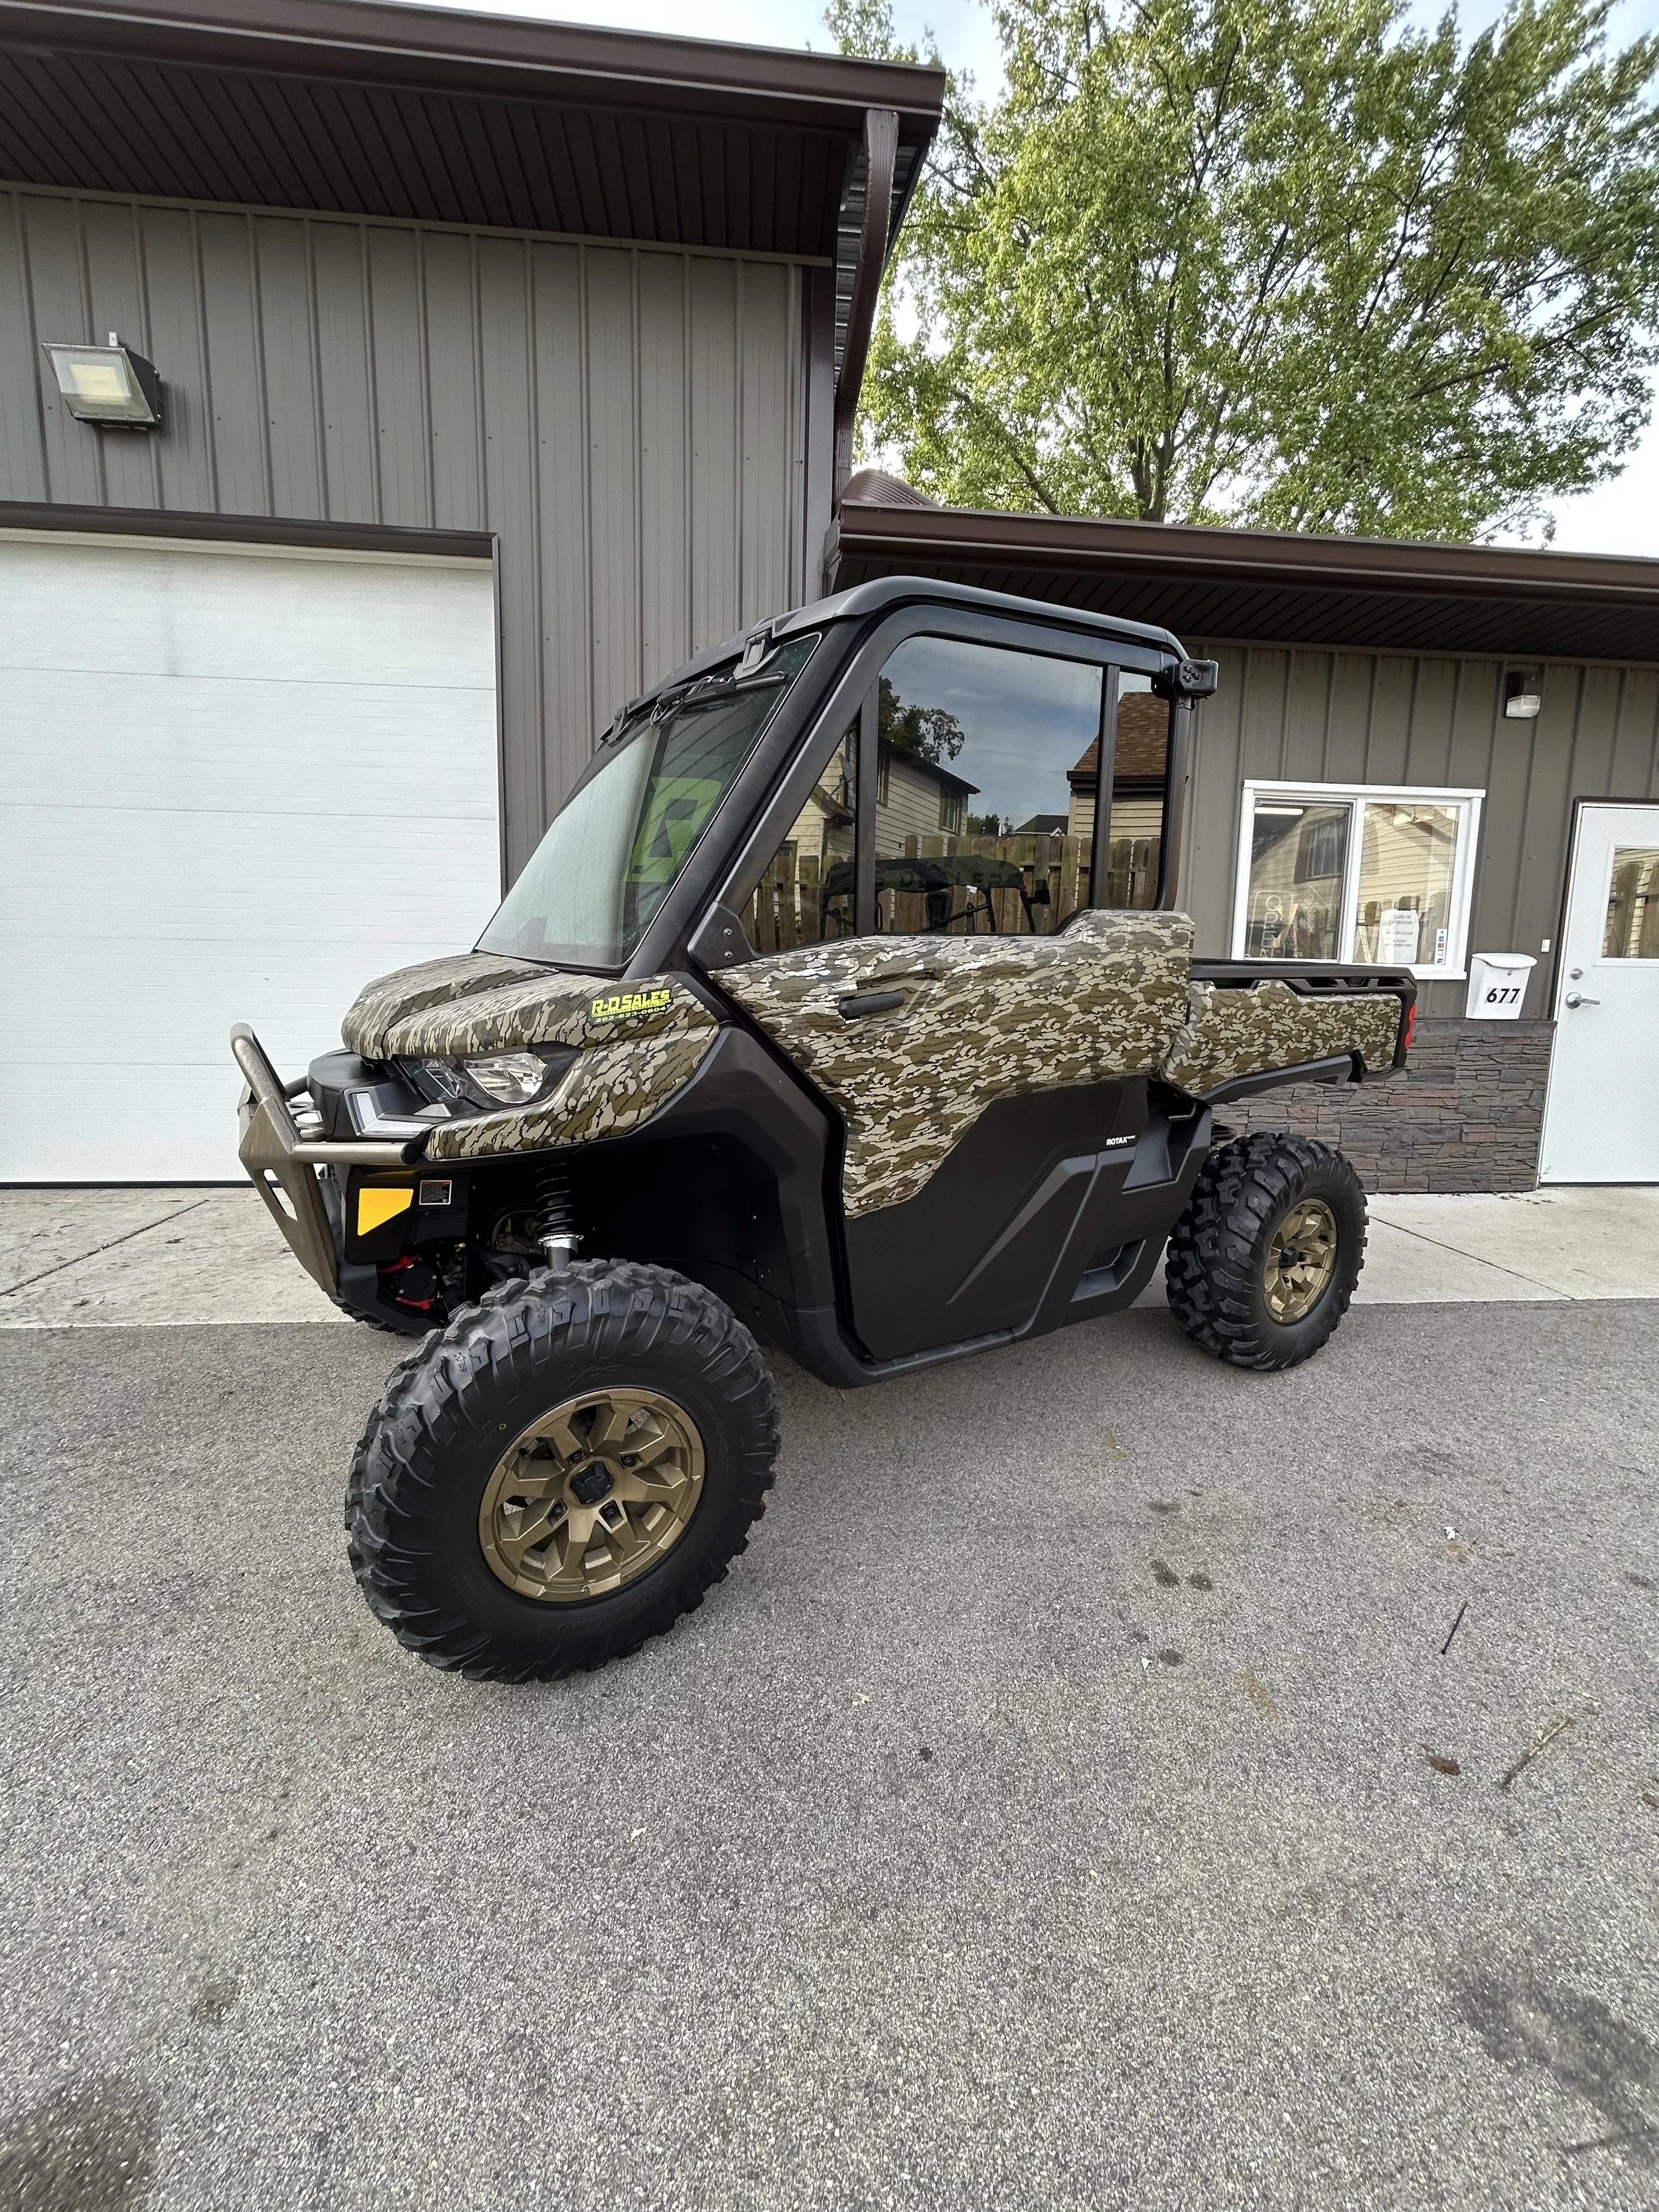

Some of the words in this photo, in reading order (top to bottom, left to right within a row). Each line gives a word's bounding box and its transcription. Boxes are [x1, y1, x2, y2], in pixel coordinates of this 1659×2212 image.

[621, 989, 670, 1009] SALES
[1486, 988, 1521, 1003] 677
[595, 1006, 666, 1023] 262-623-0604
[1106, 1137, 1127, 1145] ROTAX
